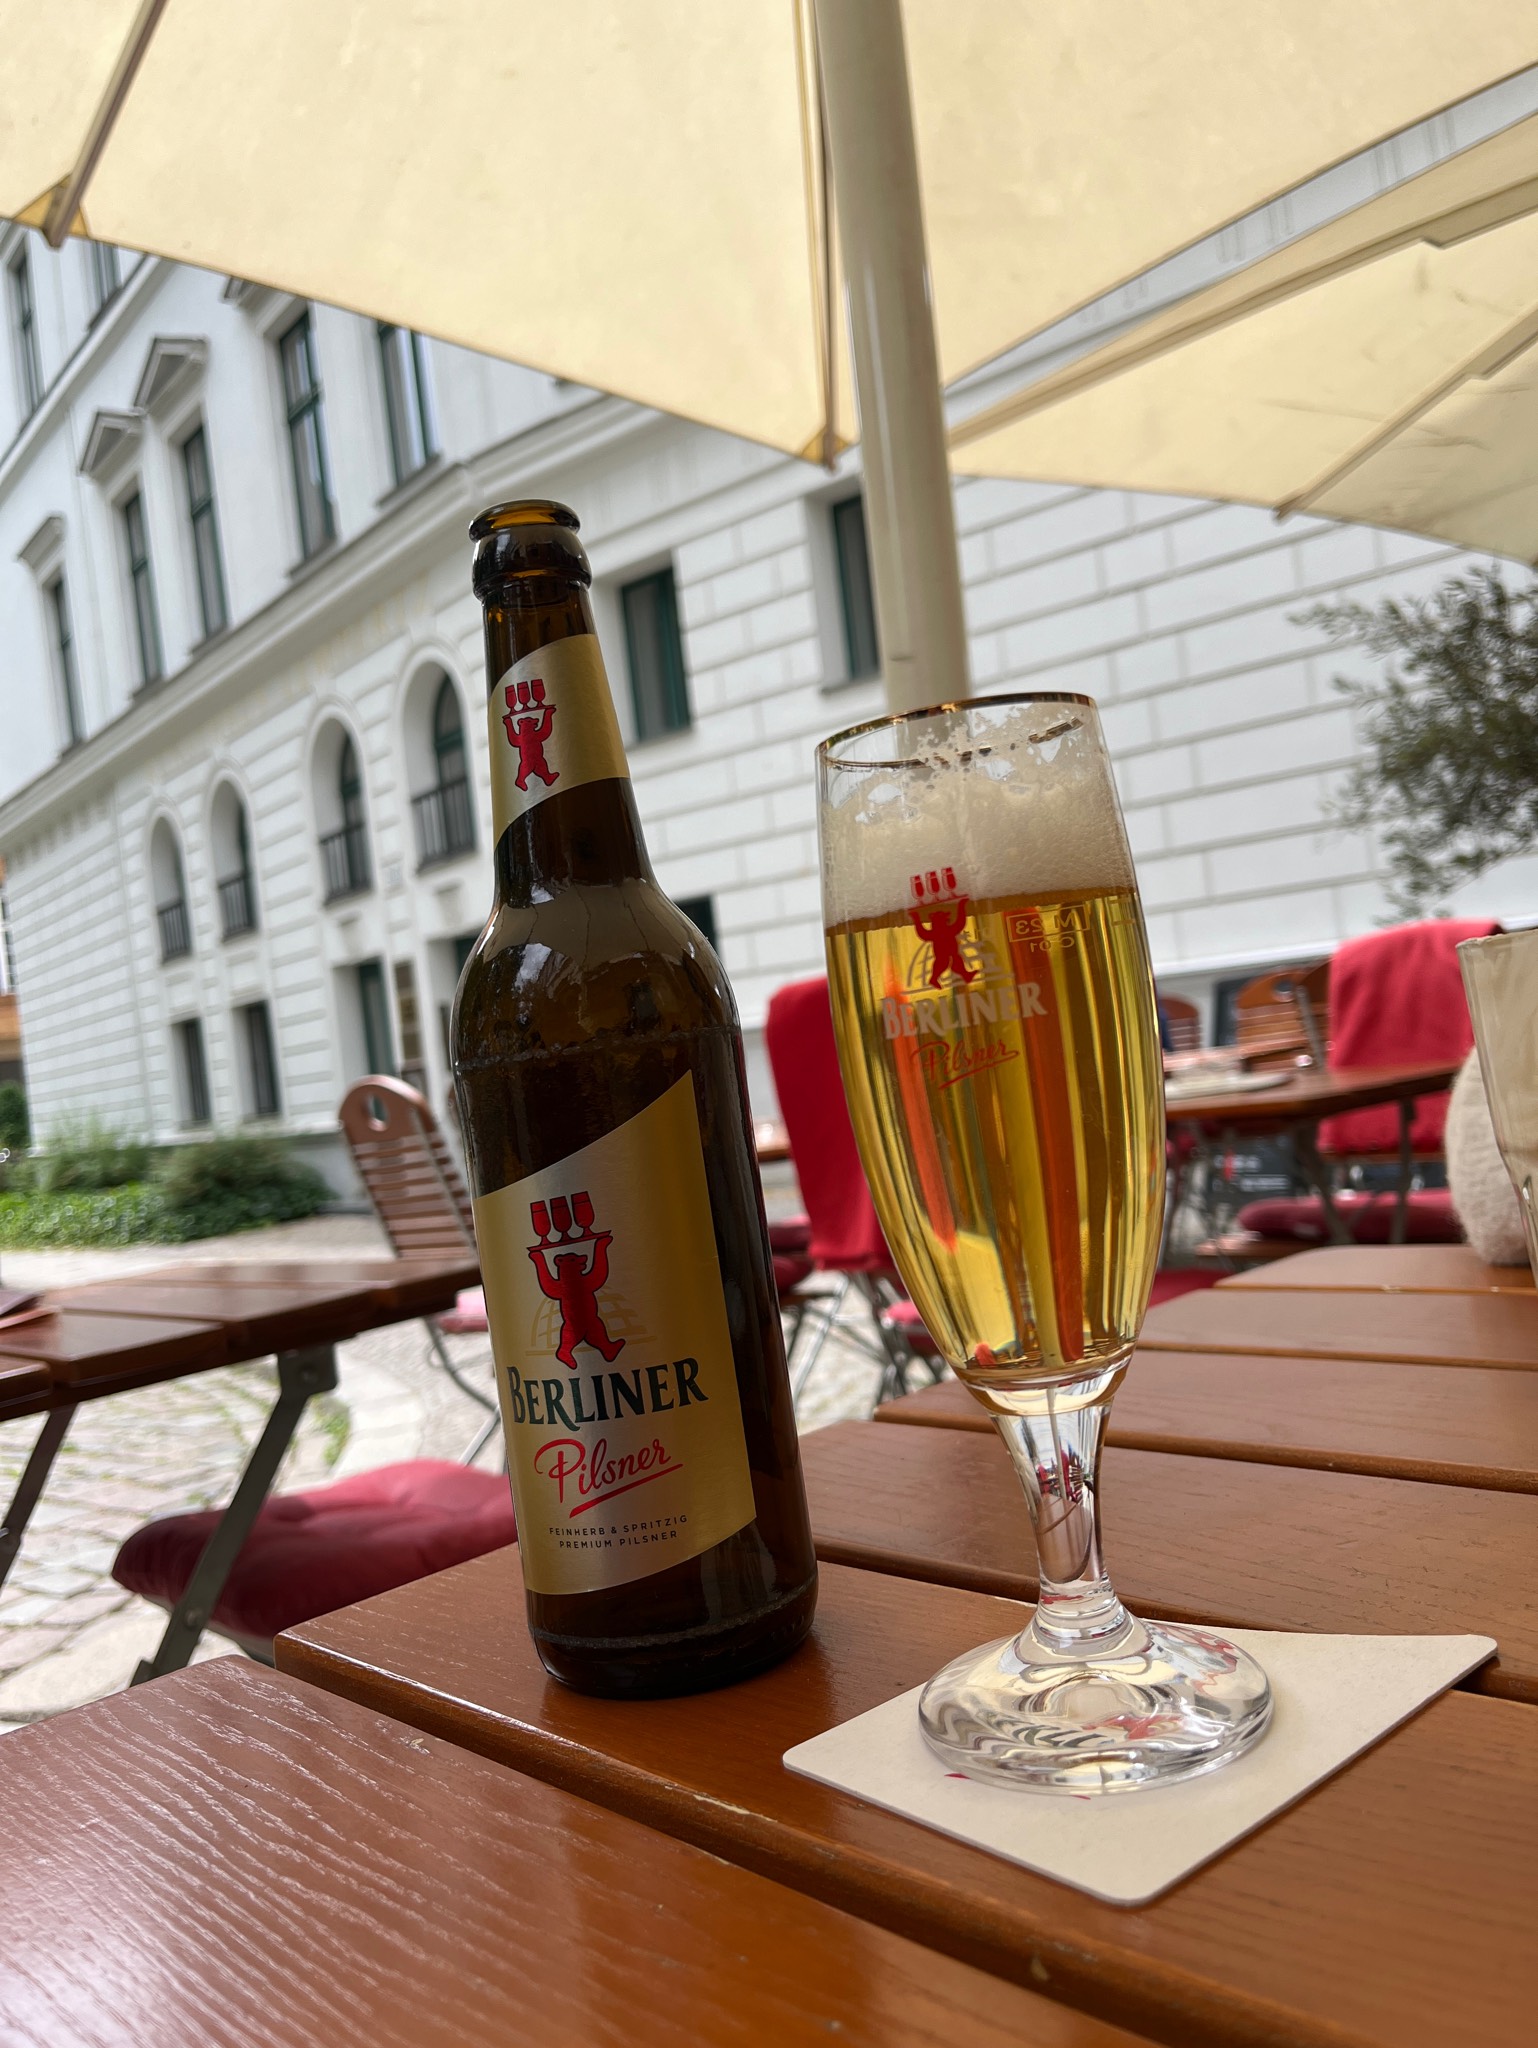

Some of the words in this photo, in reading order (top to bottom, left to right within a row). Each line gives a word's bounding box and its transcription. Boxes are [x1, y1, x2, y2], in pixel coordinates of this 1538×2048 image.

[881, 982, 1048, 1040] BERLINER
[910, 1039, 1018, 1088] Pilsner
[506, 1357, 709, 1432] BERLINER
[533, 1438, 673, 1504] Pilsner
[549, 1527, 605, 1536] FEINHERB
[610, 1526, 617, 1534] &
[623, 1515, 688, 1533] SPRITZIG
[559, 1540, 612, 1549] PREMIUM
[619, 1530, 678, 1546] PILSNER
